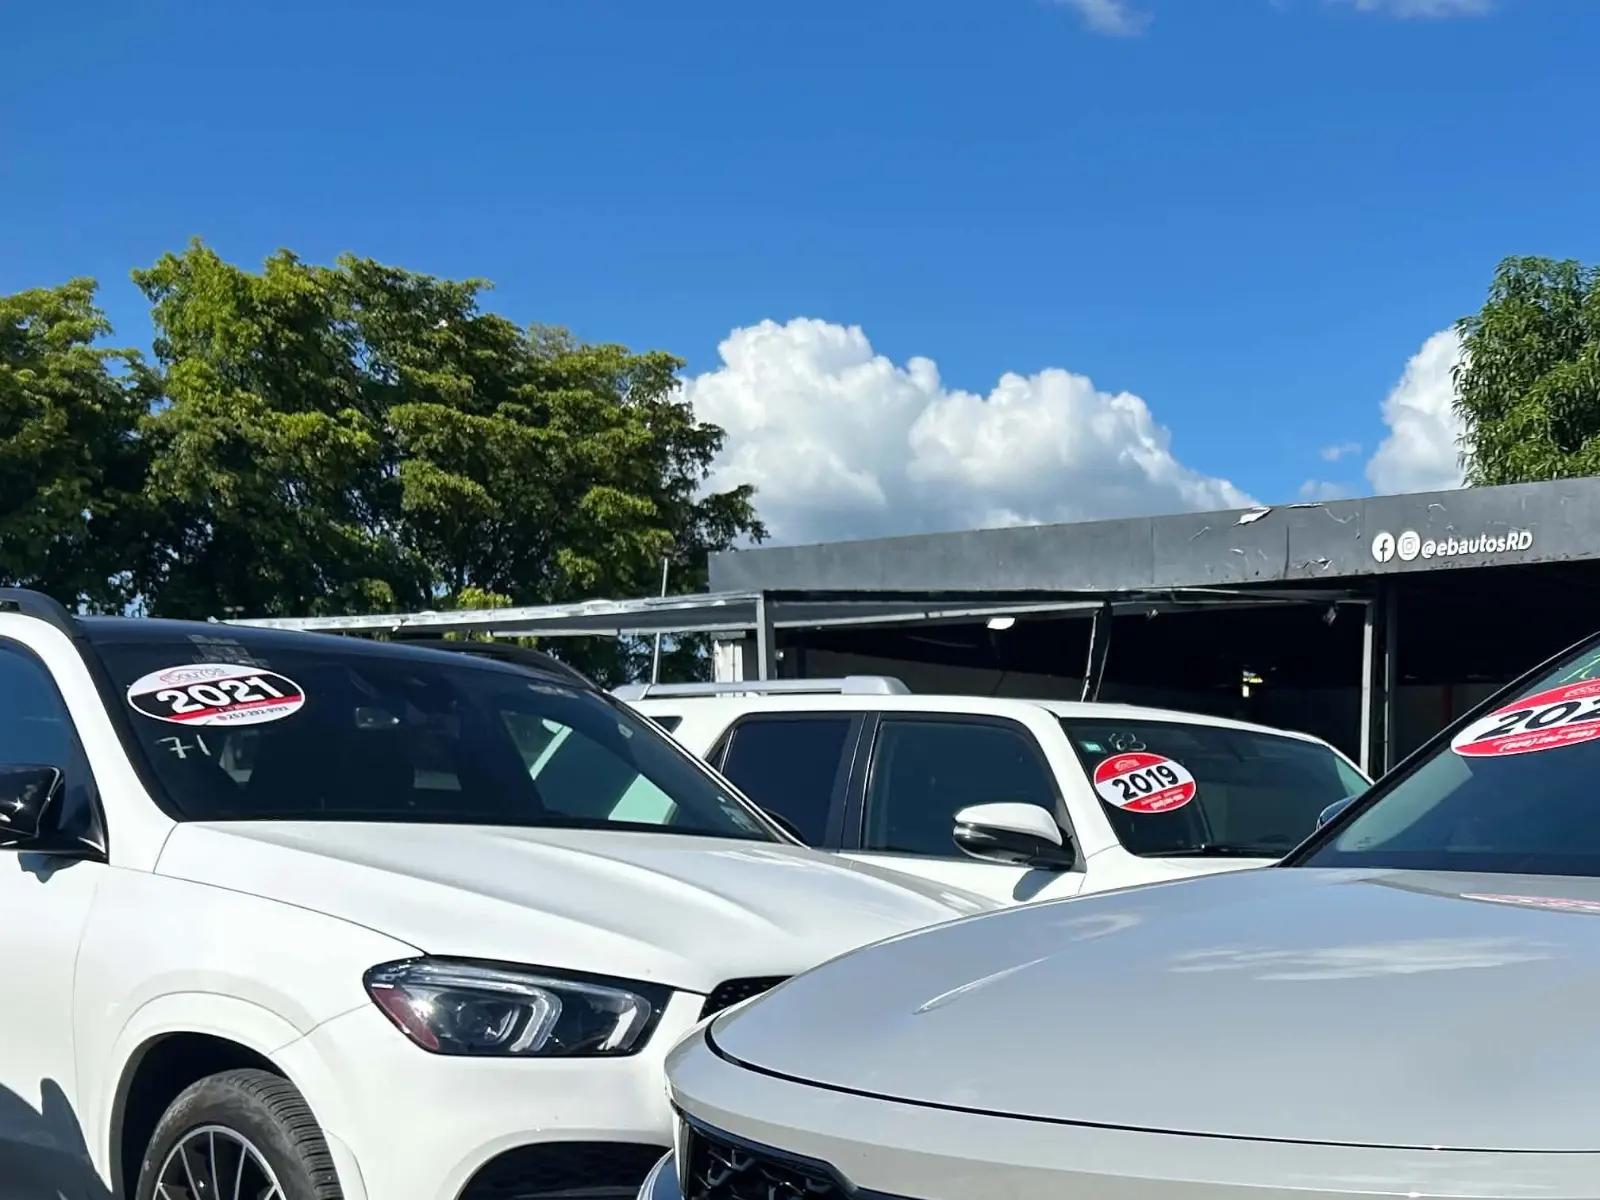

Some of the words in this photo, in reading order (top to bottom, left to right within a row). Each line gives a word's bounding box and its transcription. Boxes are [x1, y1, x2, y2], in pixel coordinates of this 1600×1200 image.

[1421, 531, 1533, 559] @ebautosRD
[156, 676, 285, 714] 2021
[1111, 765, 1179, 801] 2019
